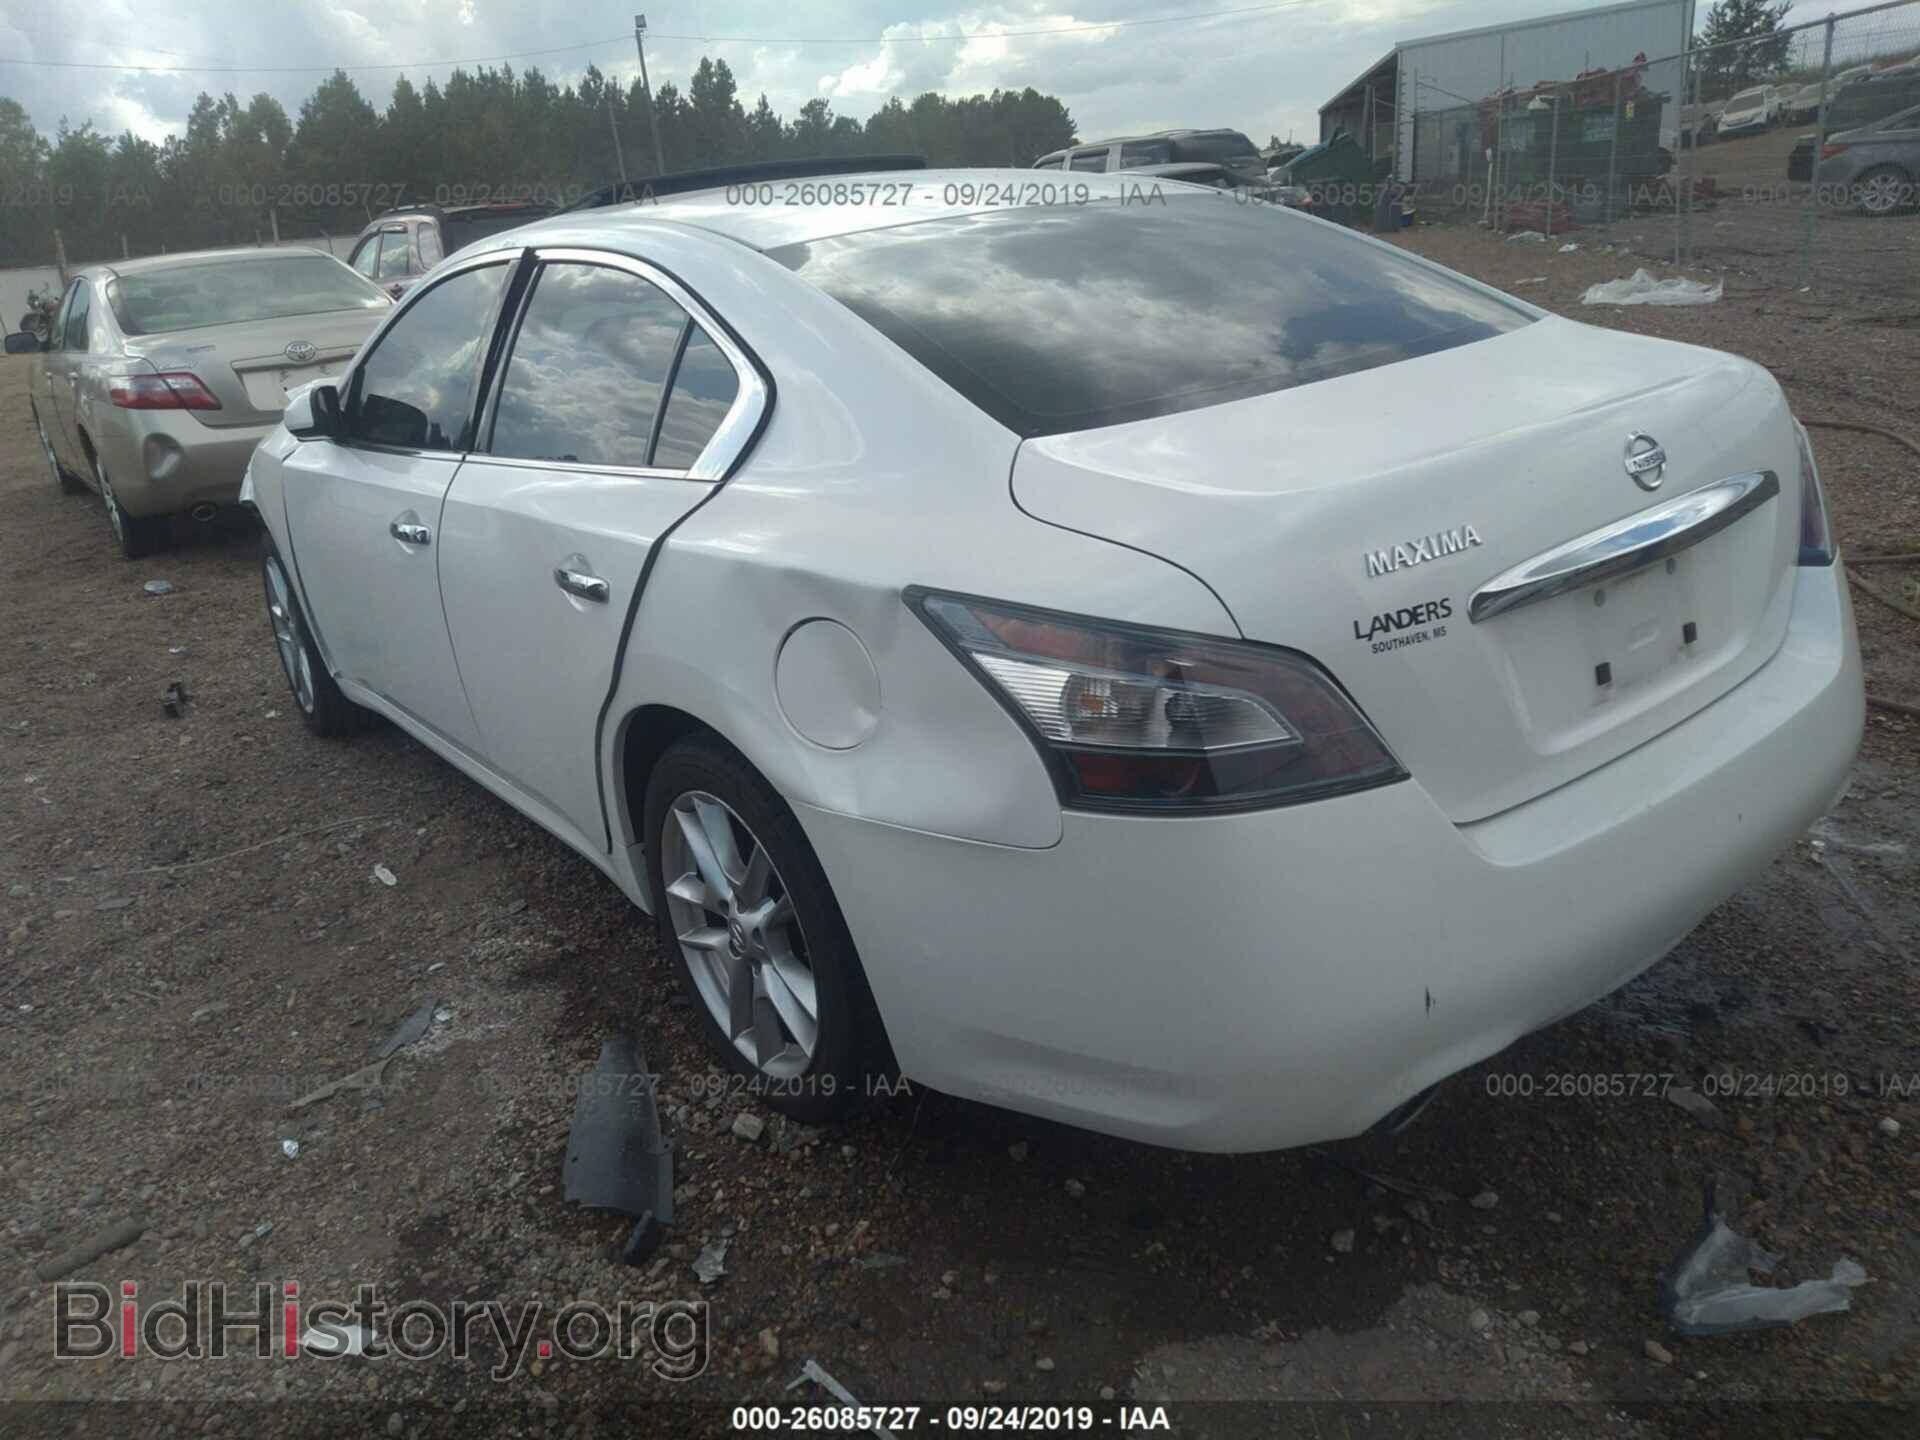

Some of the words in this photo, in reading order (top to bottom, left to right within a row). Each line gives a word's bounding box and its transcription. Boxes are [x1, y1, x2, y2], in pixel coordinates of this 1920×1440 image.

[1364, 524, 1483, 577] MAXIMA
[1353, 597, 1452, 641] LANDERS
[1371, 630, 1431, 654] SOUTHAVEN,
[1432, 625, 1447, 639] MS
